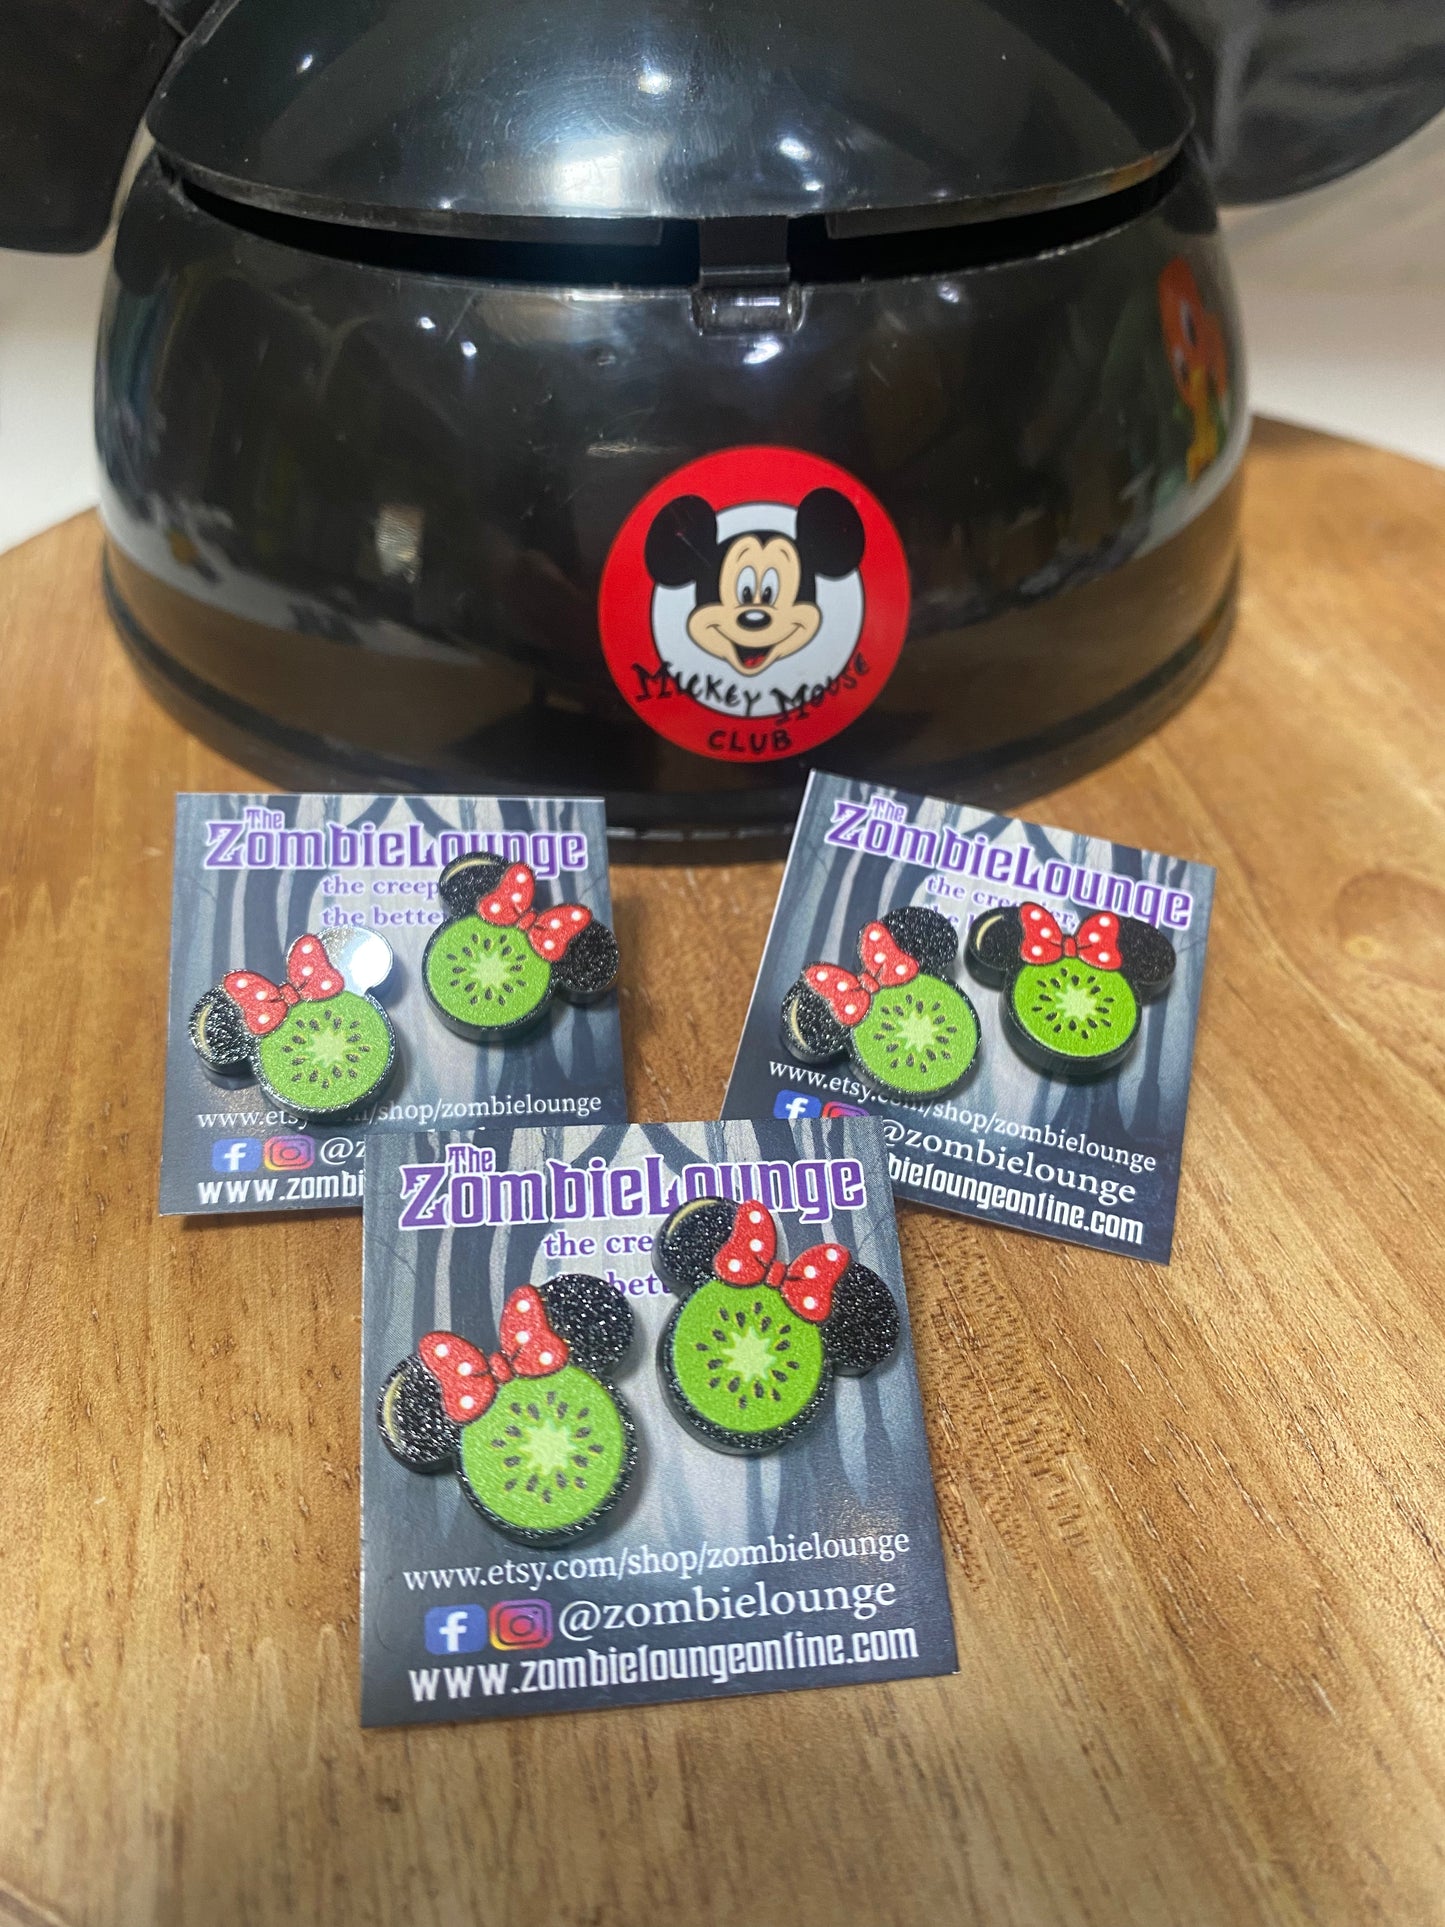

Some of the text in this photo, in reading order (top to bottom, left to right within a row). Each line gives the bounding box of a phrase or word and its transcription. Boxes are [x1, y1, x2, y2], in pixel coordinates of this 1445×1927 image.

[707, 729, 793, 754] CLUB
[244, 806, 285, 831] The
[871, 796, 907, 823] The
[205, 820, 588, 879] ZombieLounge
[825, 801, 1193, 932] ZombieLounge
[322, 874, 365, 896] the
[926, 876, 966, 900] the
[322, 906, 448, 927] the bette
[446, 1144, 495, 1174] The
[882, 1119, 1137, 1206] @zombielounge
[399, 1155, 867, 1230] ZombieLounge
[543, 1231, 596, 1257] the
[403, 1530, 910, 1592] www.etsy.com/shop/zombielounge
[558, 1581, 896, 1641] @zombielounge
[408, 1626, 919, 1702] www.zombieloungeonline.com
